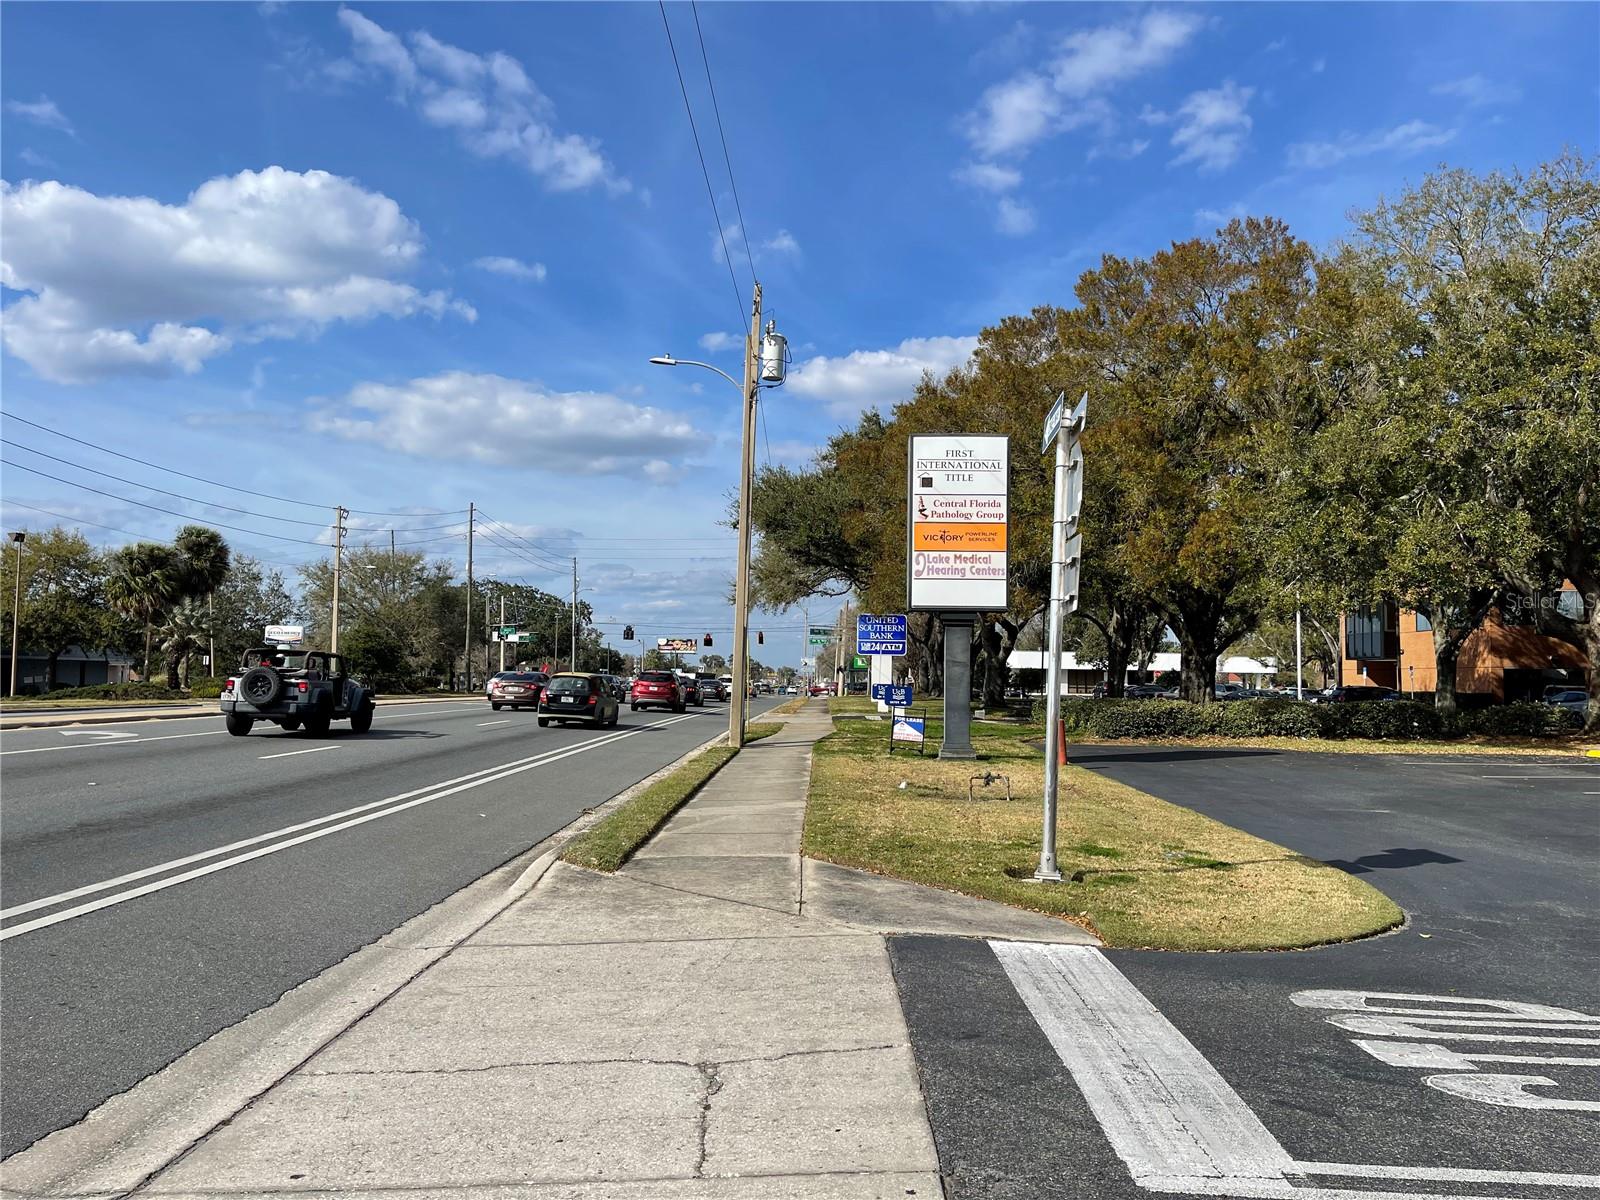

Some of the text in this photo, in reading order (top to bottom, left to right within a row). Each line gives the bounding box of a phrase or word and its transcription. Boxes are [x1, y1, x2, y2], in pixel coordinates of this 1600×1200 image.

[945, 449, 974, 458] FIRST
[916, 461, 1003, 470] INTERNATIONAL
[945, 473, 974, 482] TITLE
[933, 499, 1001, 508] Central Florida
[930, 510, 1004, 521] Pathology Group
[927, 553, 992, 564] Lake Medical
[926, 565, 1005, 577] Hearing Centers
[865, 616, 899, 624] UNITED
[859, 624, 905, 632] SOUTHERN
[870, 632, 894, 640] BANK
[870, 642, 880, 651] 24
